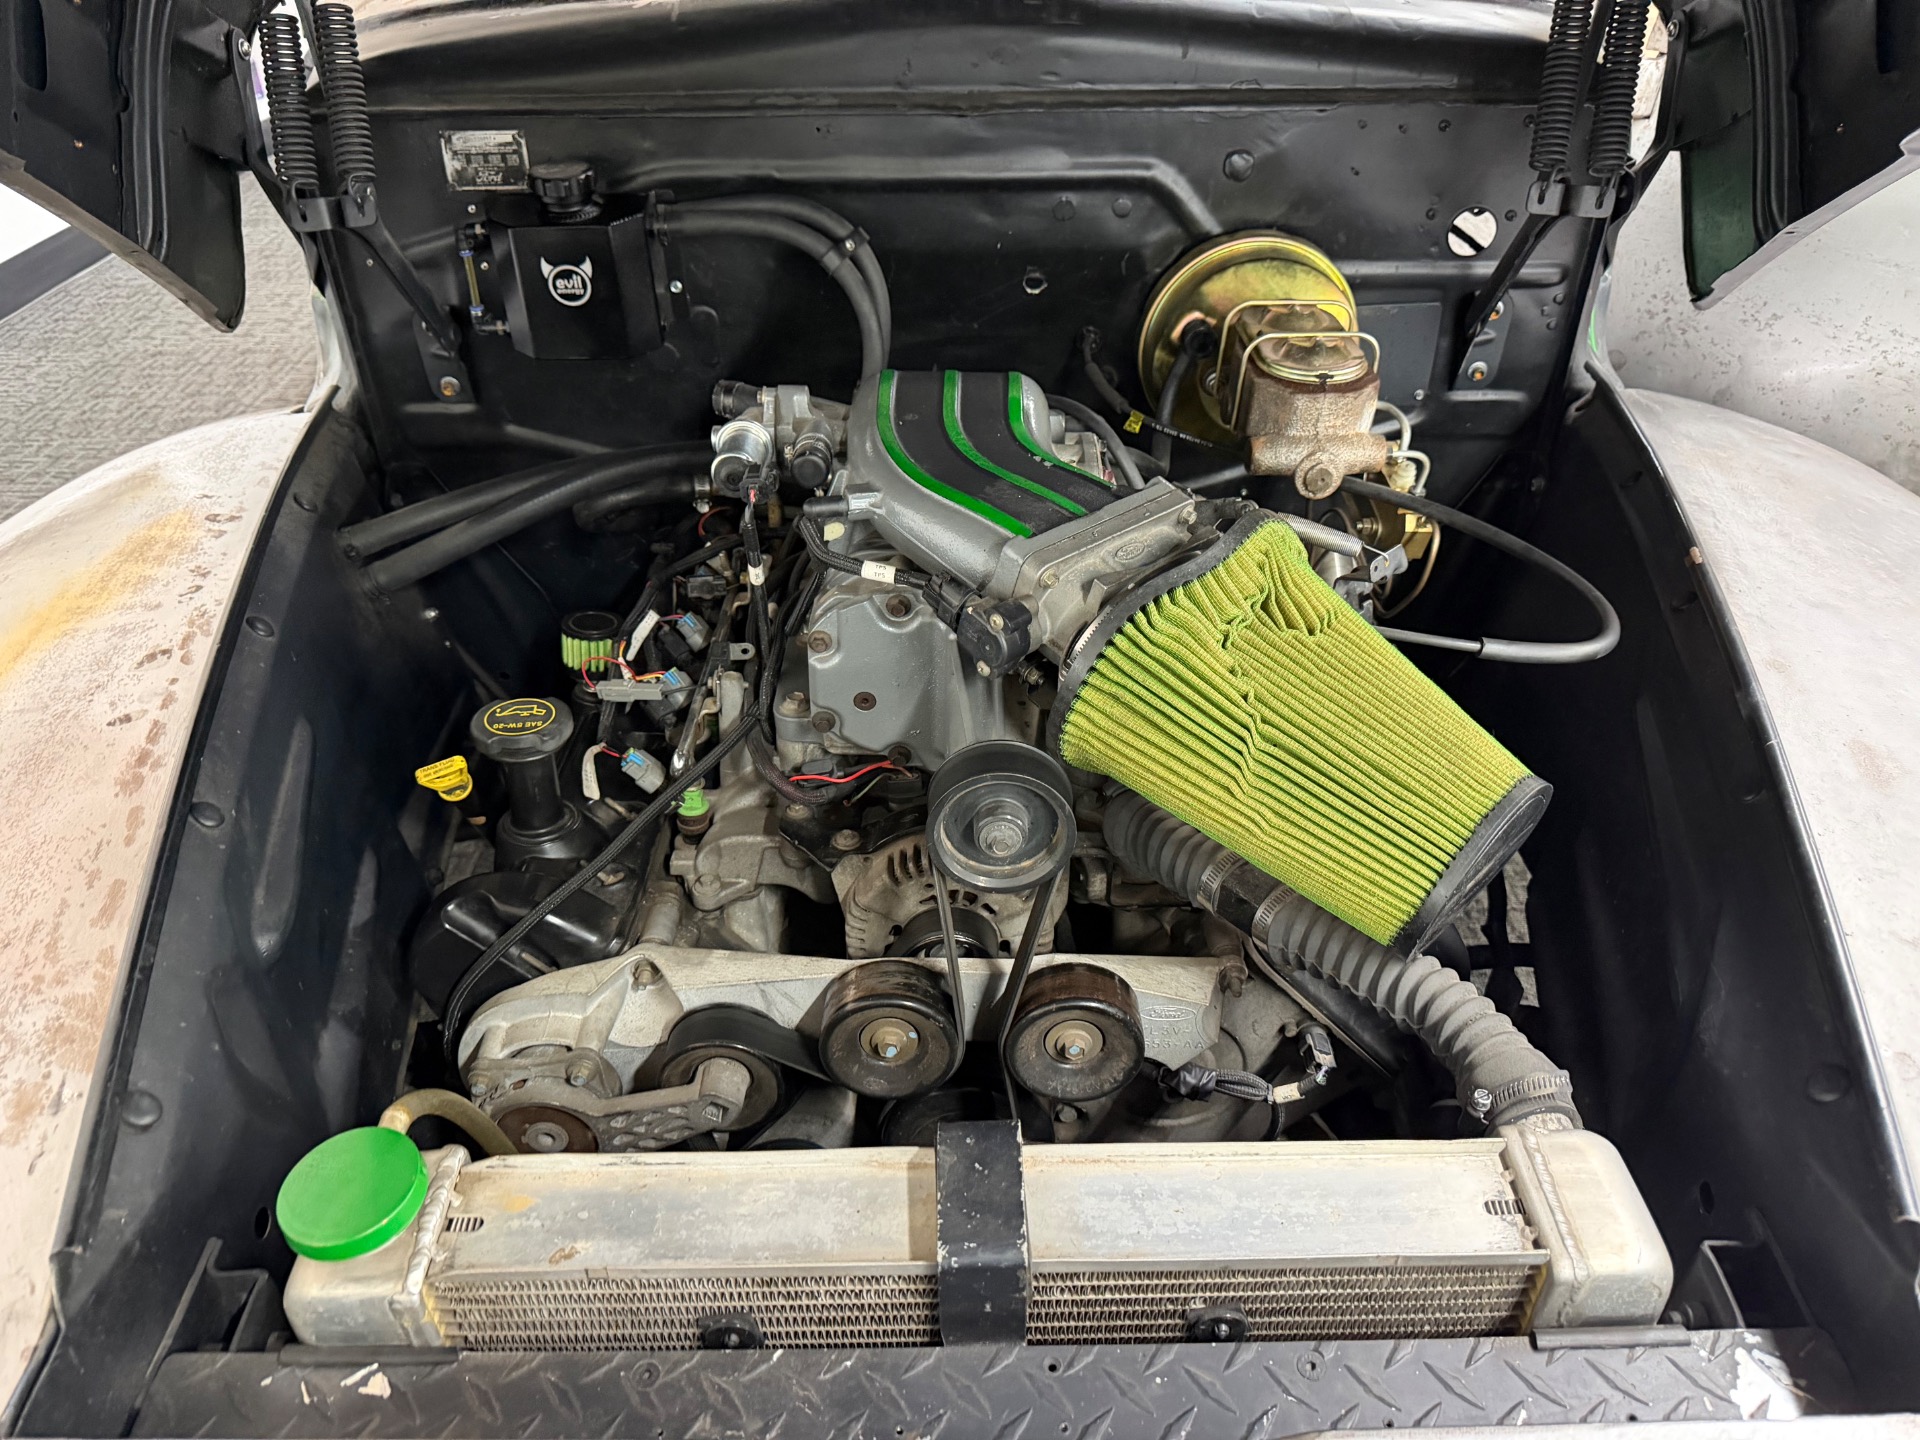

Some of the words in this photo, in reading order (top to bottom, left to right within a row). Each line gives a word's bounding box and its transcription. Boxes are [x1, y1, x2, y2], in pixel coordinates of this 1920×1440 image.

[555, 273, 583, 289] evil
[873, 571, 886, 579] TPS
[492, 721, 524, 730] 5W-20
[524, 720, 543, 728] SAE
[1143, 1025, 1191, 1036] L3V-
